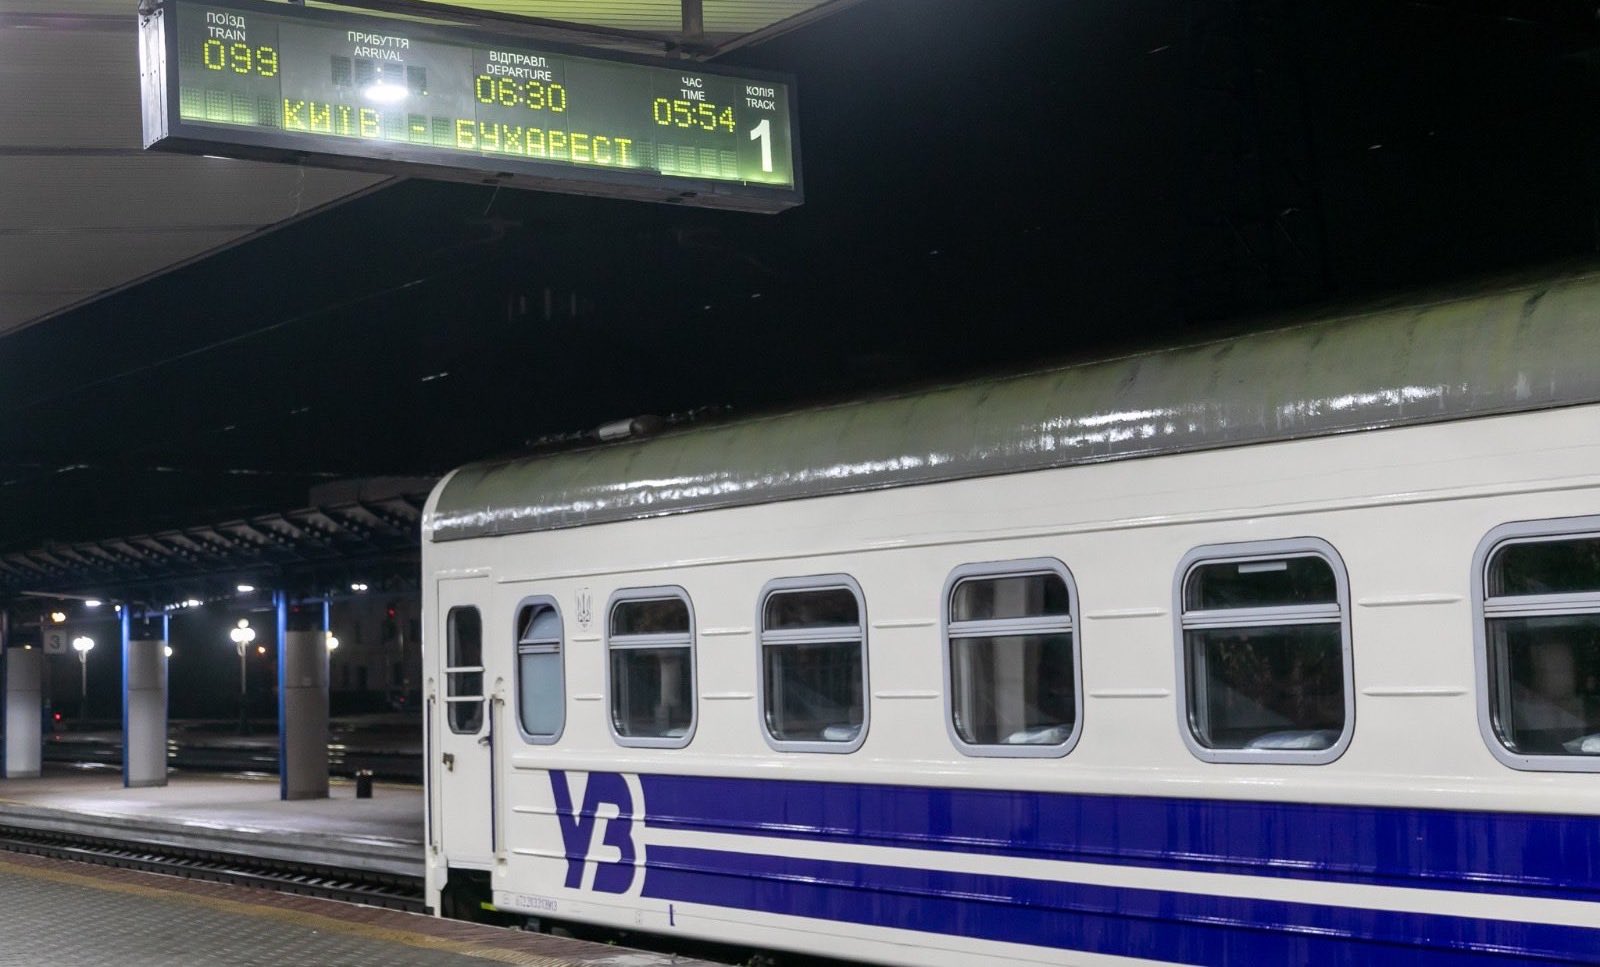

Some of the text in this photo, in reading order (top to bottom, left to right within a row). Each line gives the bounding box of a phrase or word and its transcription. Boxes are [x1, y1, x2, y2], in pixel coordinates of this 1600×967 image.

[206, 12, 246, 29] ПОЇЗД
[208, 26, 246, 41] TRAIN
[347, 30, 410, 50] ПРИБУТТЯ
[204, 39, 278, 77] 099
[353, 45, 404, 62] ARRIVAL
[489, 50, 550, 69] ВІДПРАВЛ.
[486, 64, 552, 82] DEPARTURE
[681, 76, 703, 89] ЧАС
[475, 75, 567, 112] 06:30
[680, 88, 706, 102] TIME
[745, 85, 775, 99] КОЛІЯ
[745, 97, 776, 111] TRACK
[653, 97, 736, 133] 05:54
[284, 98, 381, 138] КИЇВ
[456, 119, 632, 165] БУХАРЕСТ
[749, 119, 773, 173] 1
[49, 634, 60, 649] 3
